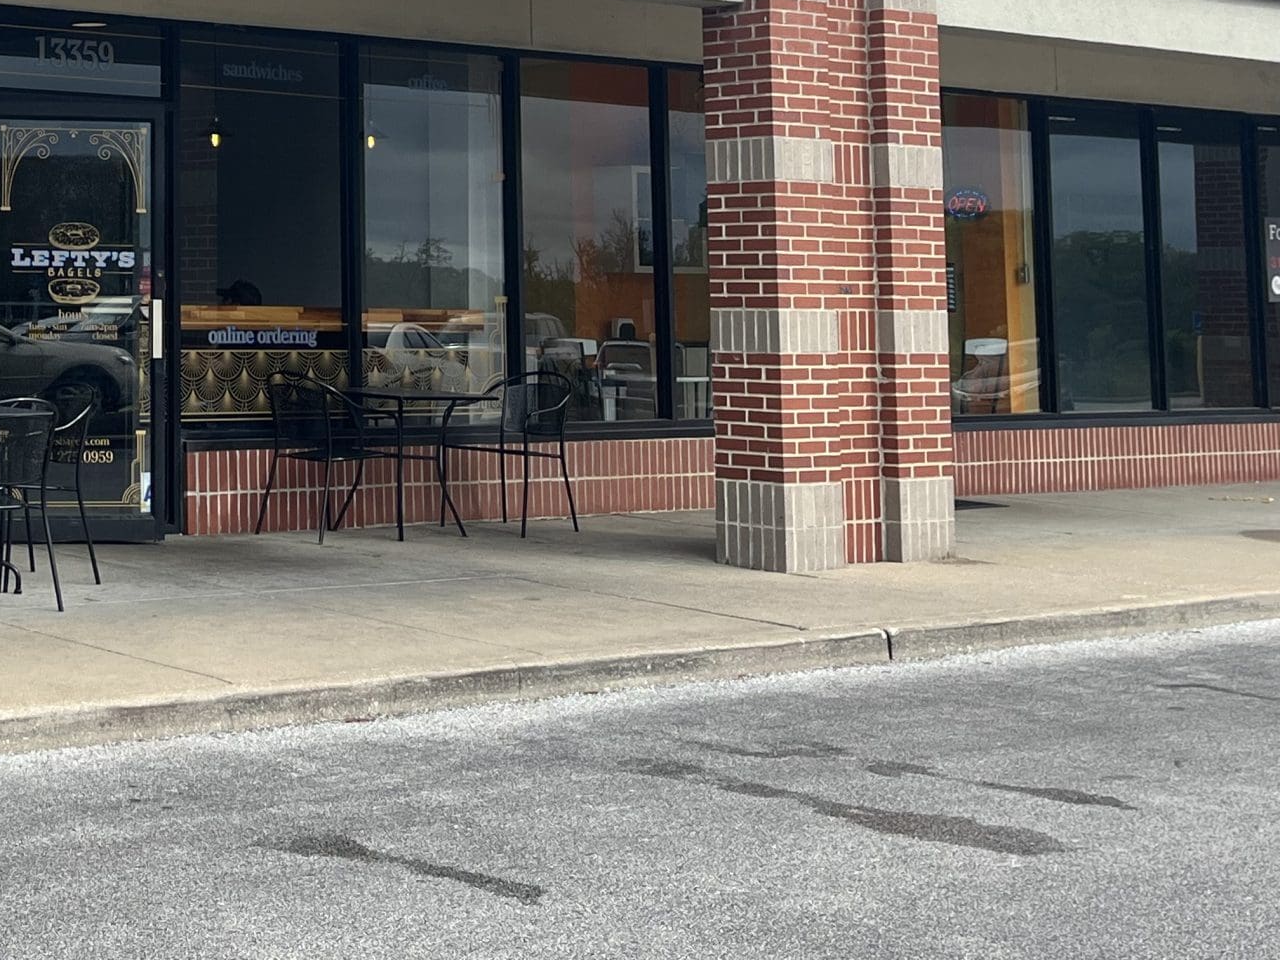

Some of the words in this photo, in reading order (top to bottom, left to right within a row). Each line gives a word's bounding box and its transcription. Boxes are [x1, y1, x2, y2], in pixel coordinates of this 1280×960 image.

[35, 35, 115, 71] 13359
[222, 59, 304, 83] sandwiches
[11, 248, 136, 269] LEFTY'S
[47, 267, 102, 278] BAGELS
[208, 325, 255, 344] online
[257, 326, 318, 348] ordering
